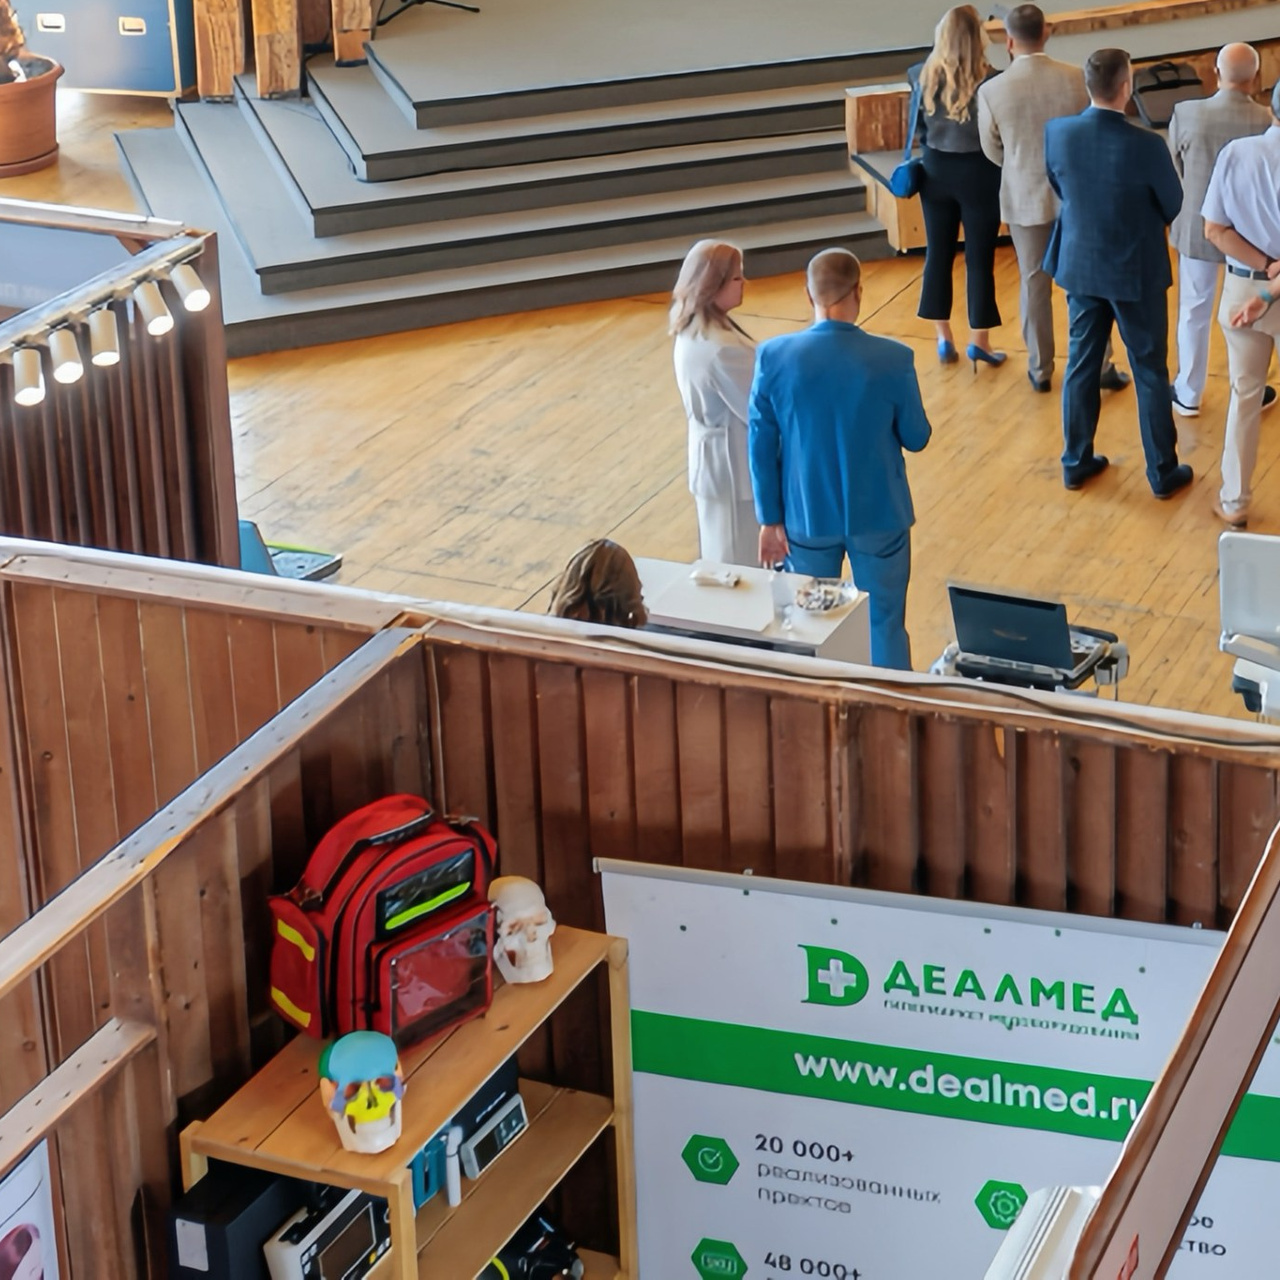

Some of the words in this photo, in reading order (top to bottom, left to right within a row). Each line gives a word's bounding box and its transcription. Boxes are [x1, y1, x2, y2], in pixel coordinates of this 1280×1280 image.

[884, 959, 1139, 1025] ДЕАЛМЕД
[755, 1133, 783, 1154] 20
[792, 1140, 854, 1162] 000+
[764, 1252, 792, 1271] 48
